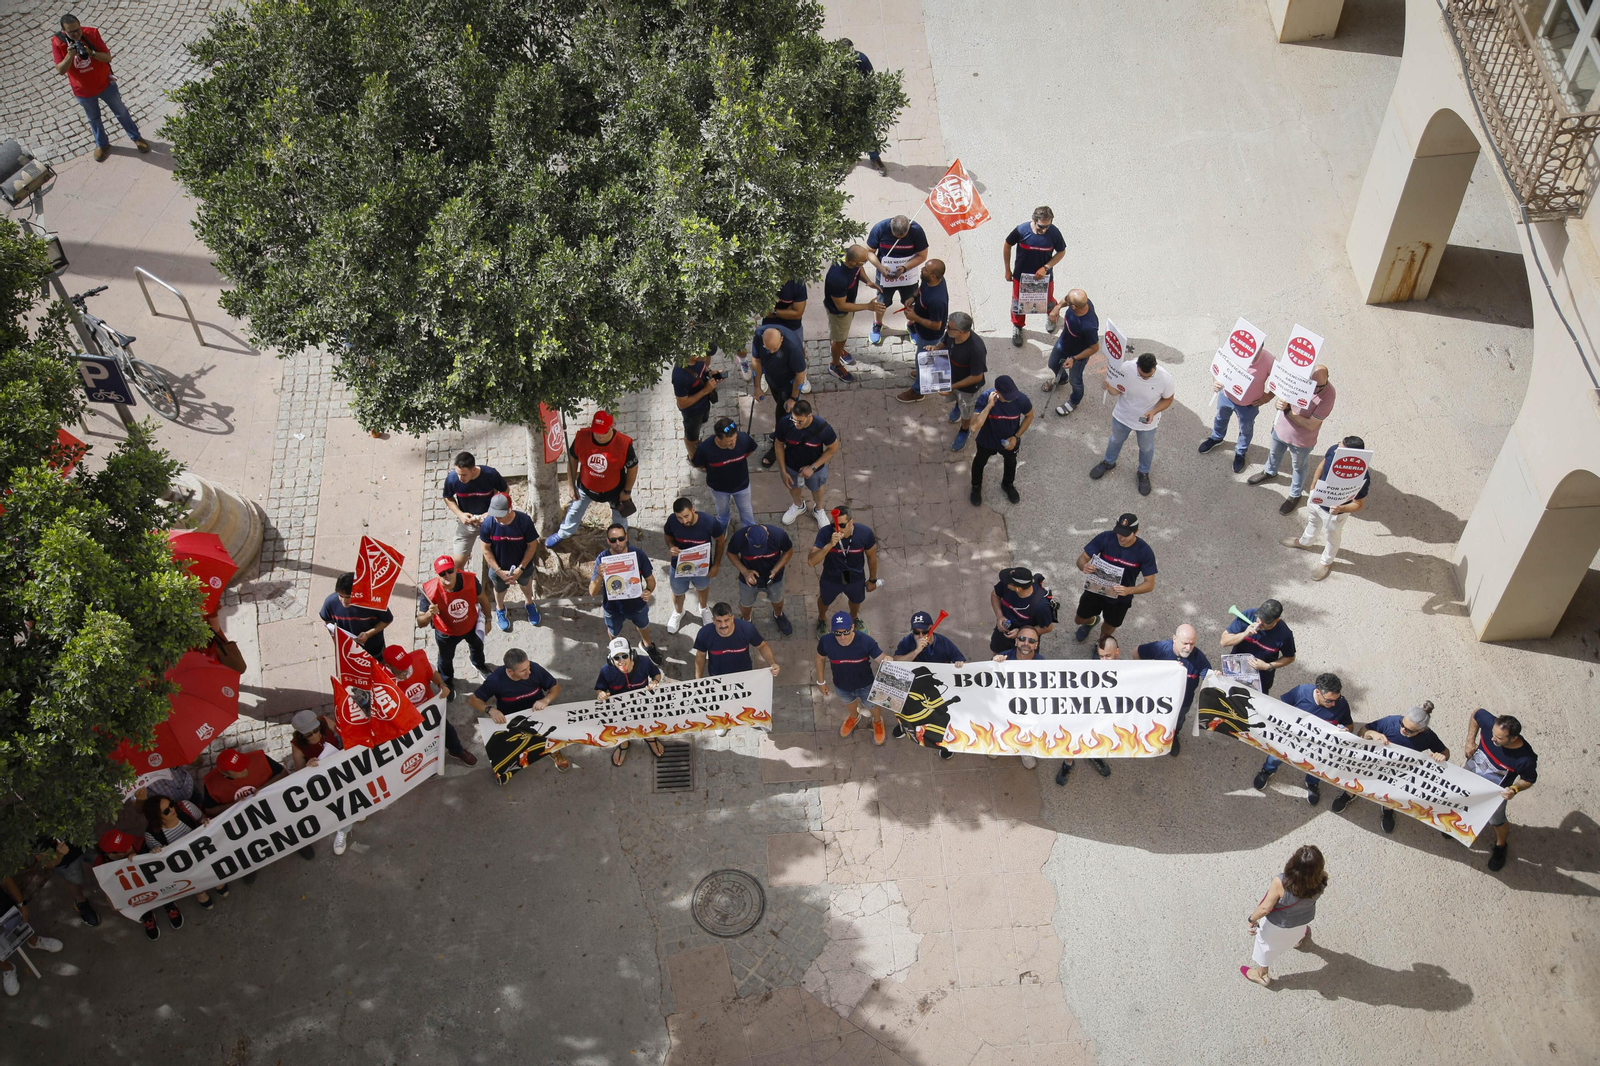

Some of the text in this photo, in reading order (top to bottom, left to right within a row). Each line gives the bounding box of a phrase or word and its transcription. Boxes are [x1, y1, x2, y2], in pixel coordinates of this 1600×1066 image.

[1231, 335, 1255, 354] ALMERIA
[1239, 330, 1254, 344] UEA
[1296, 337, 1313, 350] UEA
[1230, 342, 1250, 358] UEMA
[1288, 344, 1314, 361] ALMERIA
[1288, 352, 1309, 366] UEMA
[79, 361, 109, 388] P
[590, 456, 605, 466] UGT
[1335, 470, 1360, 478] UEMA
[450, 601, 466, 612] UGT
[952, 670, 1118, 690] BOMBEROS
[373, 685, 398, 717] UGT
[406, 684, 424, 699] UGT
[566, 682, 745, 717] NO SE PUEDE DAR UN
[594, 677, 722, 706] SIN INVERSIÓN
[567, 691, 752, 725] SERVICIO DE CALIDAD
[597, 704, 720, 726] AL CIUDADANO
[1008, 696, 1173, 716] QUEMADOS
[1295, 717, 1446, 774] LAS INSTALACIONES
[403, 753, 422, 771] UGT
[1267, 714, 1471, 798] DEL PARQUE DE BOMBEROS
[1273, 727, 1449, 800] SON LA VERGÜENZA DEL
[222, 799, 277, 841] UN
[282, 704, 442, 813] CONVENIO
[1258, 730, 1469, 813] AYUNTAMIENTO DE ALMERÍA
[236, 787, 255, 801] UGT
[211, 775, 391, 881] DIGNO YA!!
[131, 891, 155, 904] UGT
